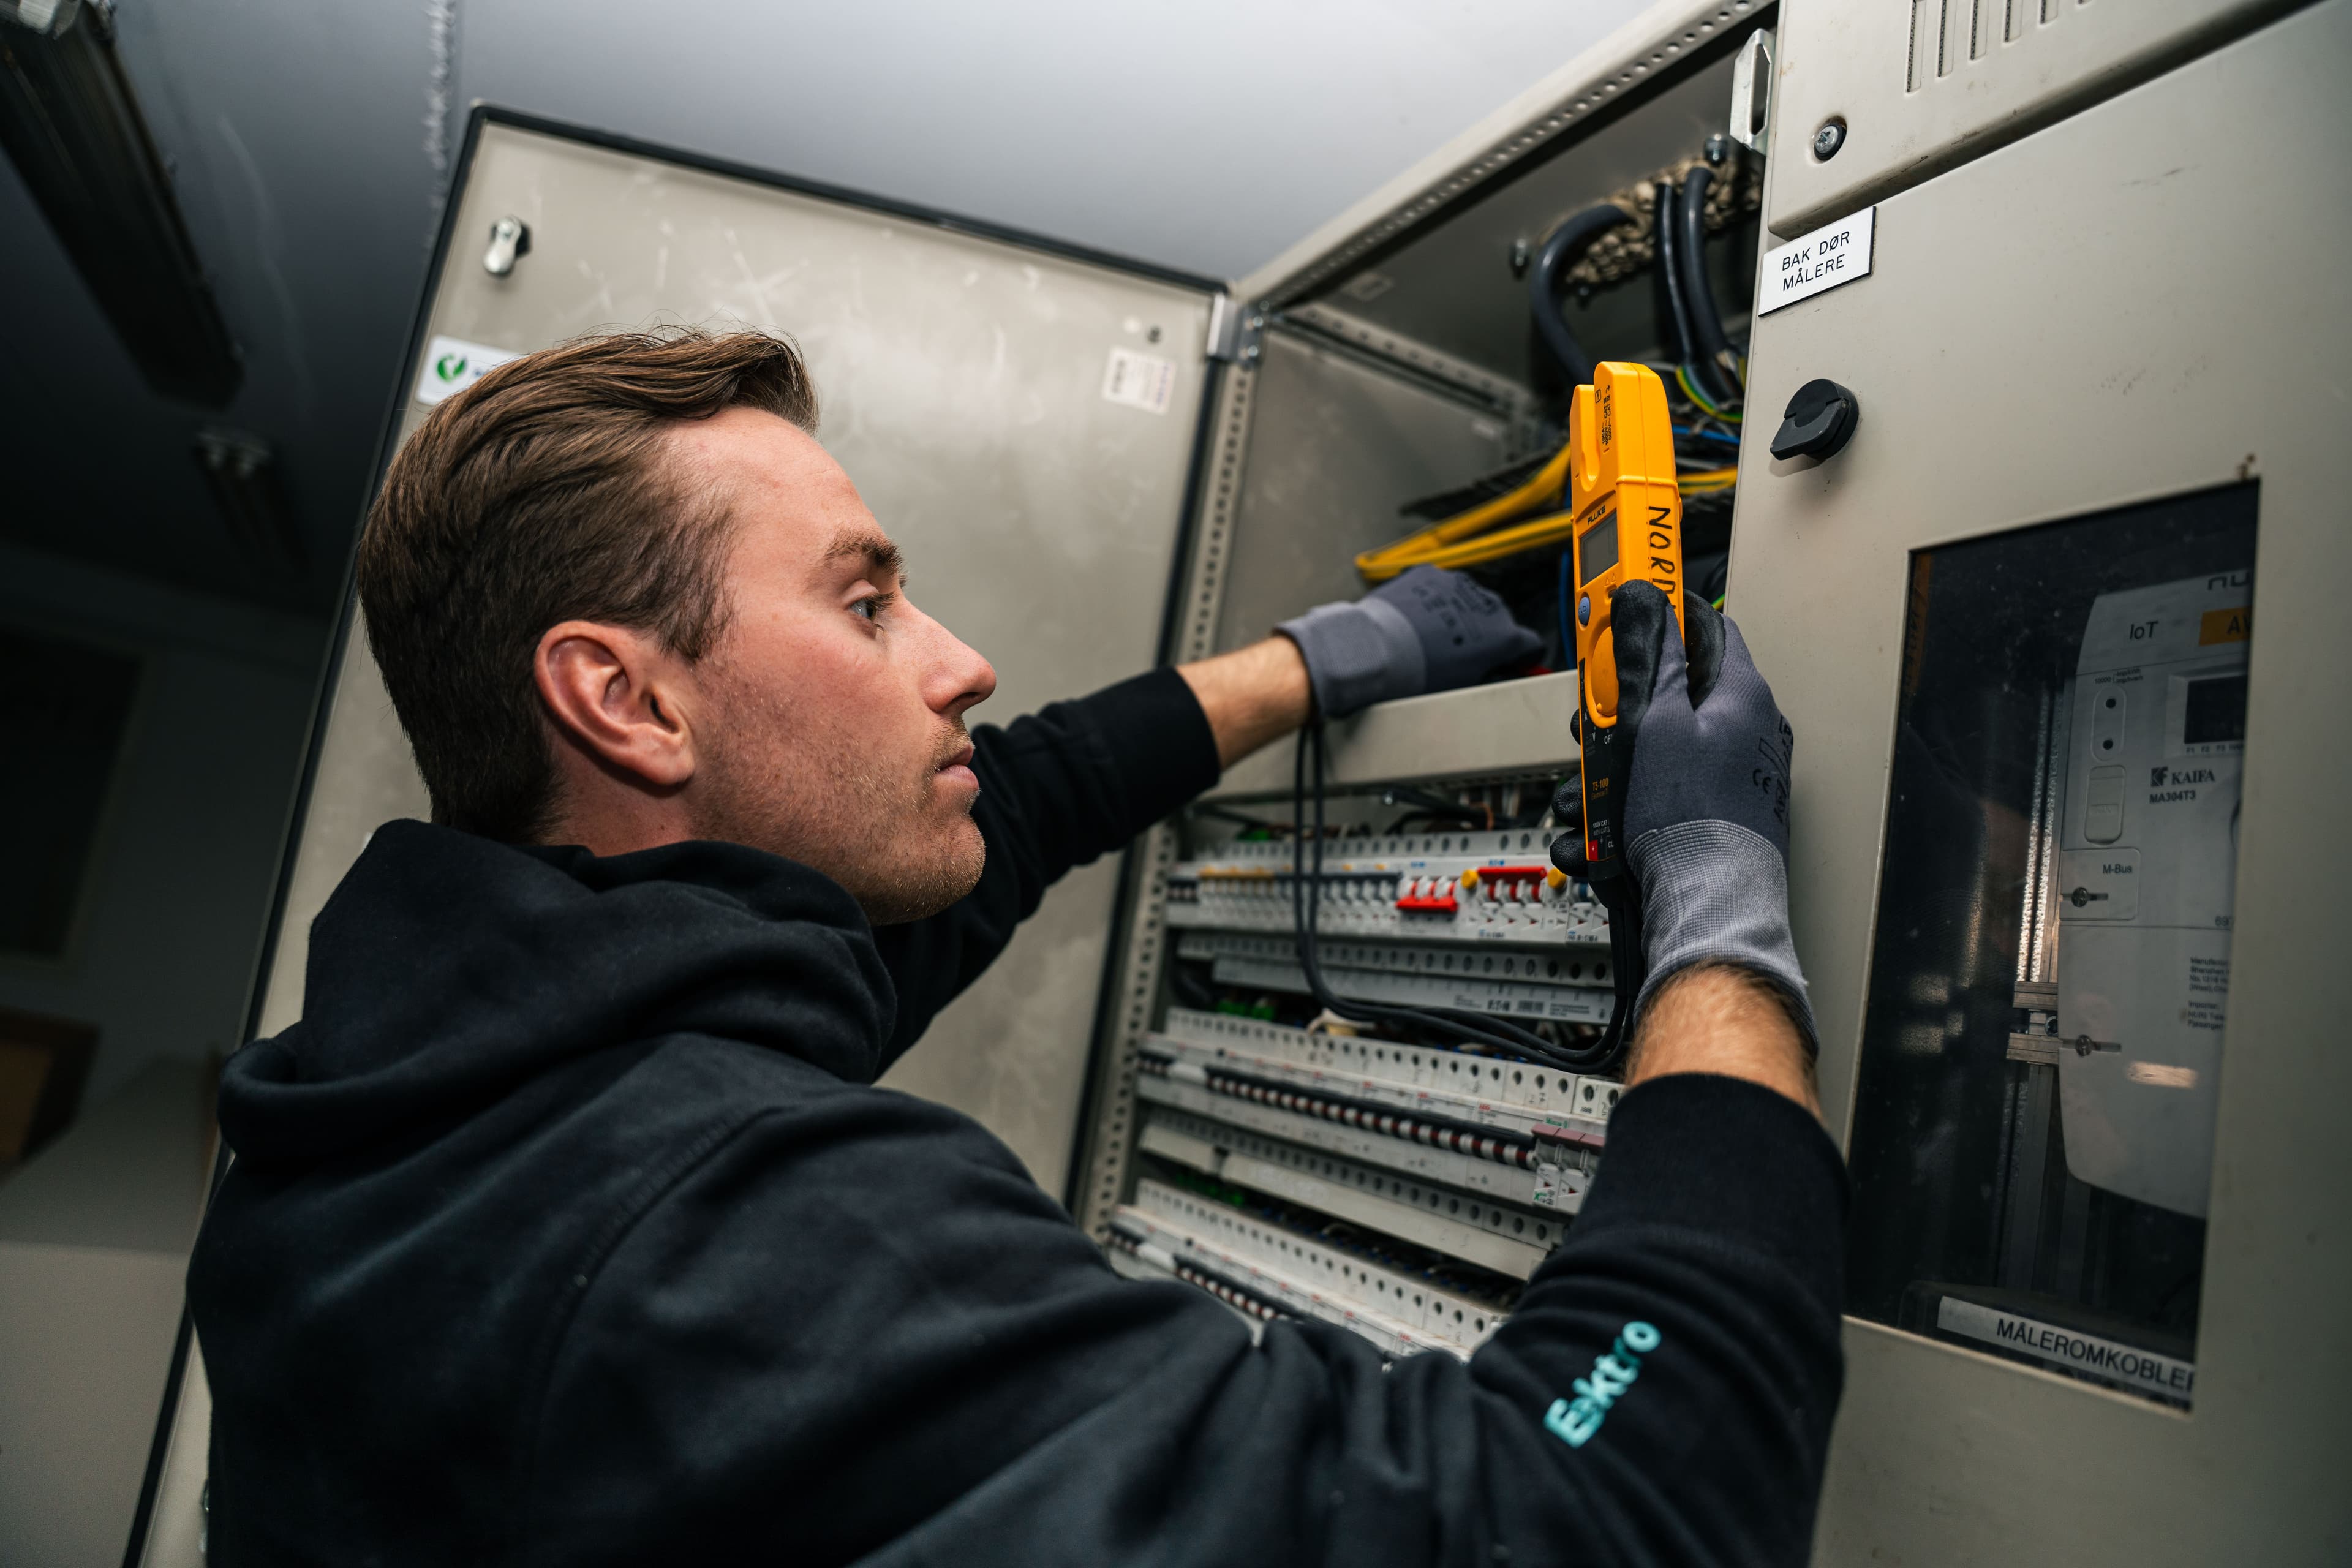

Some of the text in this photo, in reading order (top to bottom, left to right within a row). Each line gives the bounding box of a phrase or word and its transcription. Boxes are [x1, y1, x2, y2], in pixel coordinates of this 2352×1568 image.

[1782, 231, 1850, 271] BAK DØR
[1783, 254, 1845, 292] MÅLERE
[1587, 505, 1606, 526] FLUKE
[1646, 506, 1677, 611] NORD
[2129, 620, 2160, 641] IoT
[2171, 769, 2215, 785] KAIFA
[2149, 790, 2196, 804] MA304T3
[2102, 864, 2133, 875] M-Bus
